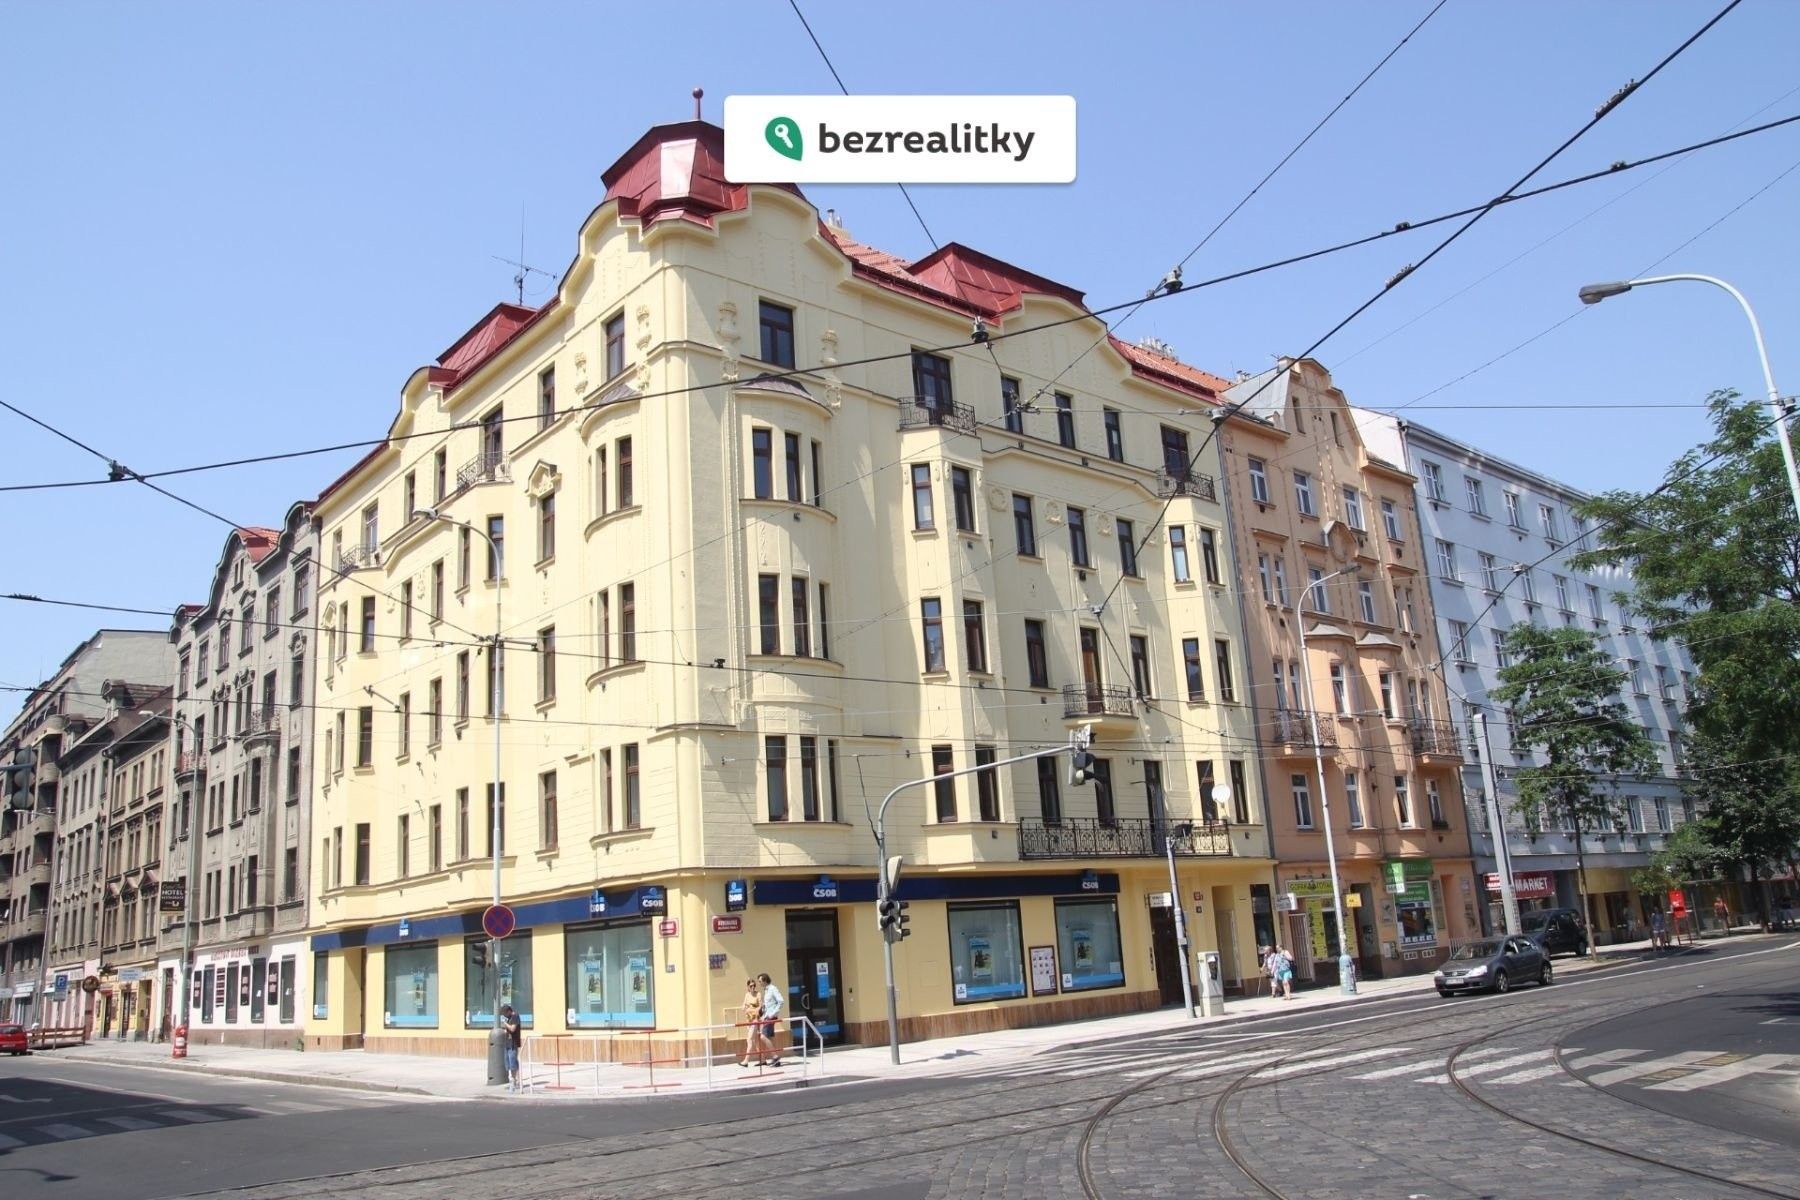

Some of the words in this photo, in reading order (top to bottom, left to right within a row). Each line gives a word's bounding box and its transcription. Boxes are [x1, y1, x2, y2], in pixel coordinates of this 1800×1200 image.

[1514, 877, 1548, 892] MARKET
[813, 888, 837, 898] ČSOB
[642, 898, 664, 908] ČSOB
